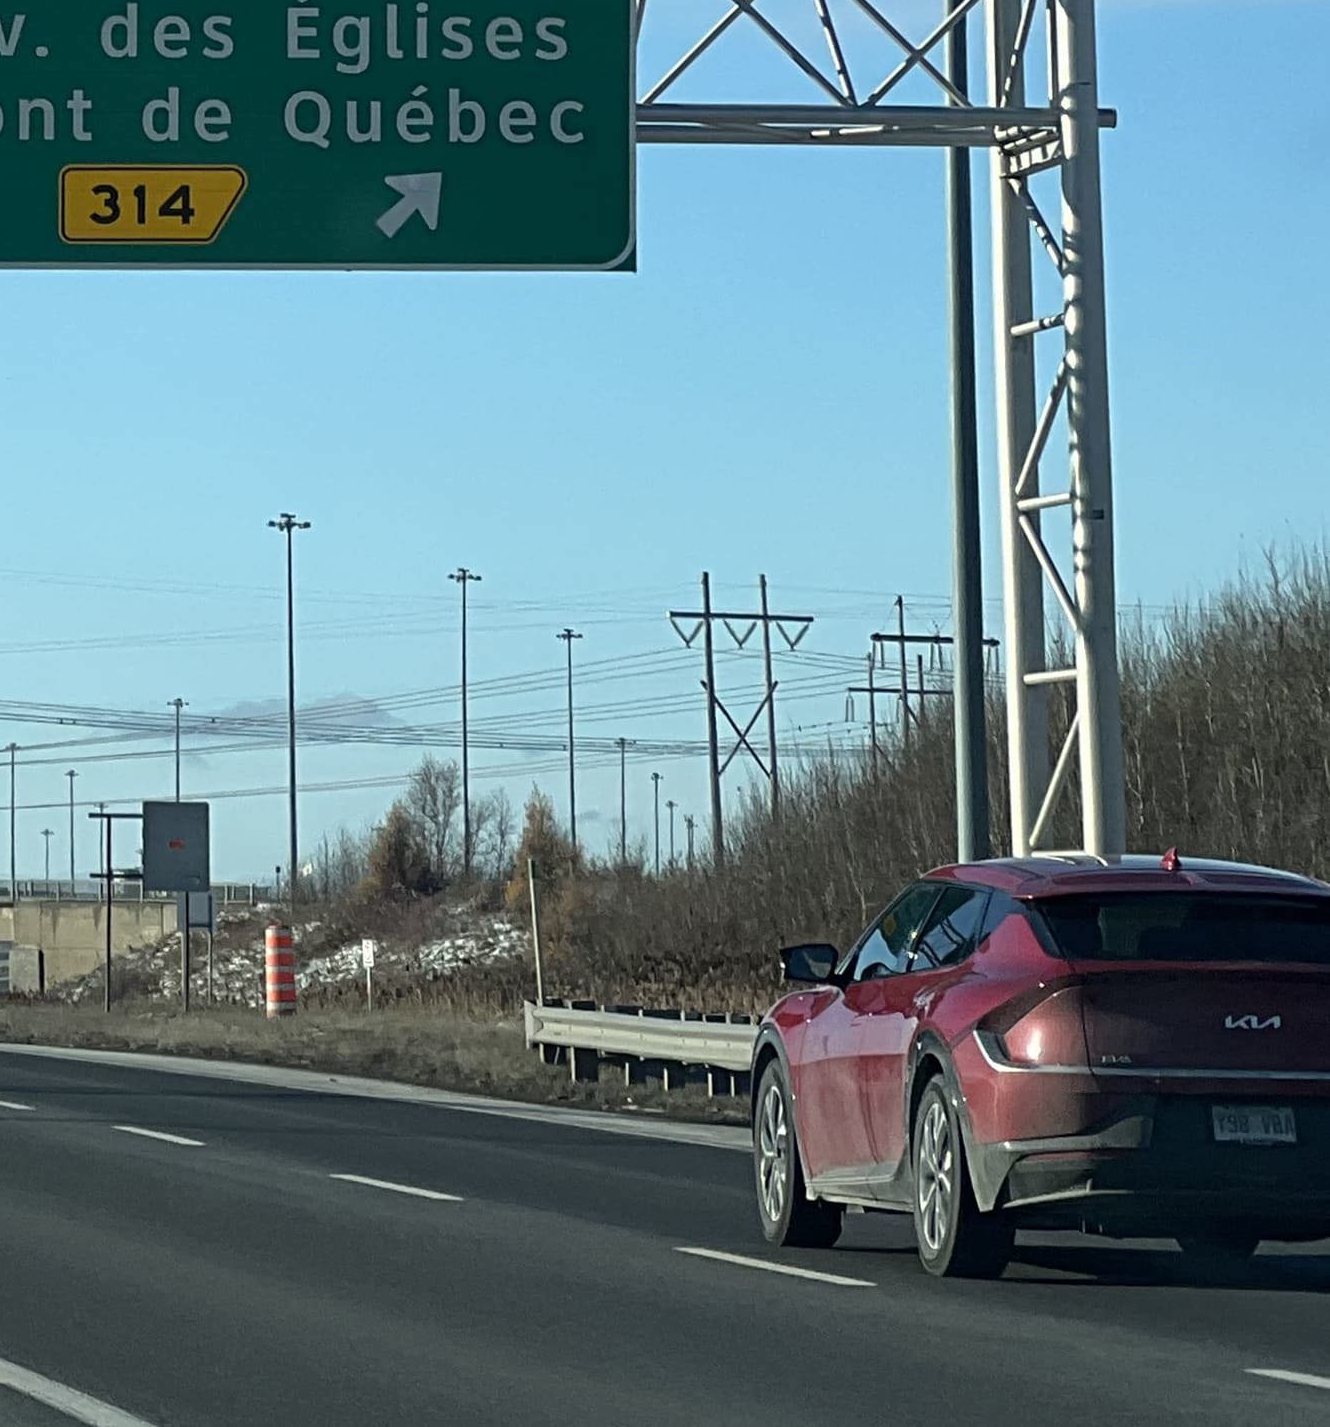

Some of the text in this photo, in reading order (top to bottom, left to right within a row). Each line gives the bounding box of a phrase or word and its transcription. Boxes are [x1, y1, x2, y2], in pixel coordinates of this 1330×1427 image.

[101, 2, 234, 59] des
[142, 86, 232, 142] de
[284, 84, 584, 148] Québec
[89, 184, 195, 225] 314
[1224, 1015, 1281, 1030] KIA
